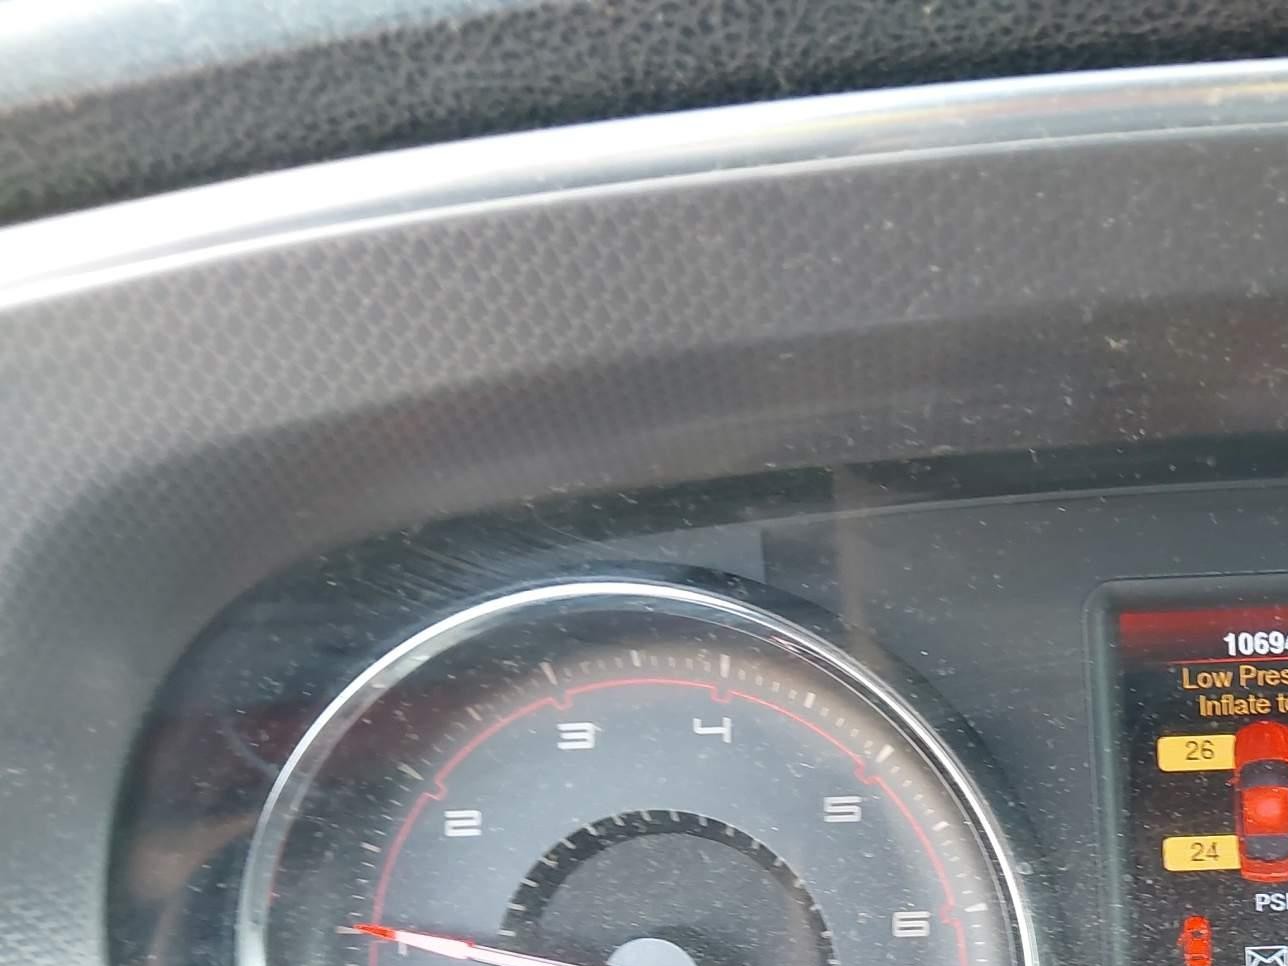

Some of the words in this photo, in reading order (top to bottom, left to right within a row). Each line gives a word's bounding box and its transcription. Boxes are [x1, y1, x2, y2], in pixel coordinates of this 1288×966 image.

[1181, 667, 1233, 690] Low
[1200, 694, 1271, 717] Inflate
[557, 722, 596, 749] 3
[693, 717, 731, 743] 4
[1185, 741, 1215, 761] 26
[823, 796, 861, 823] 5
[444, 810, 481, 837] 2
[1190, 842, 1220, 862] 24
[892, 911, 931, 938] 6
